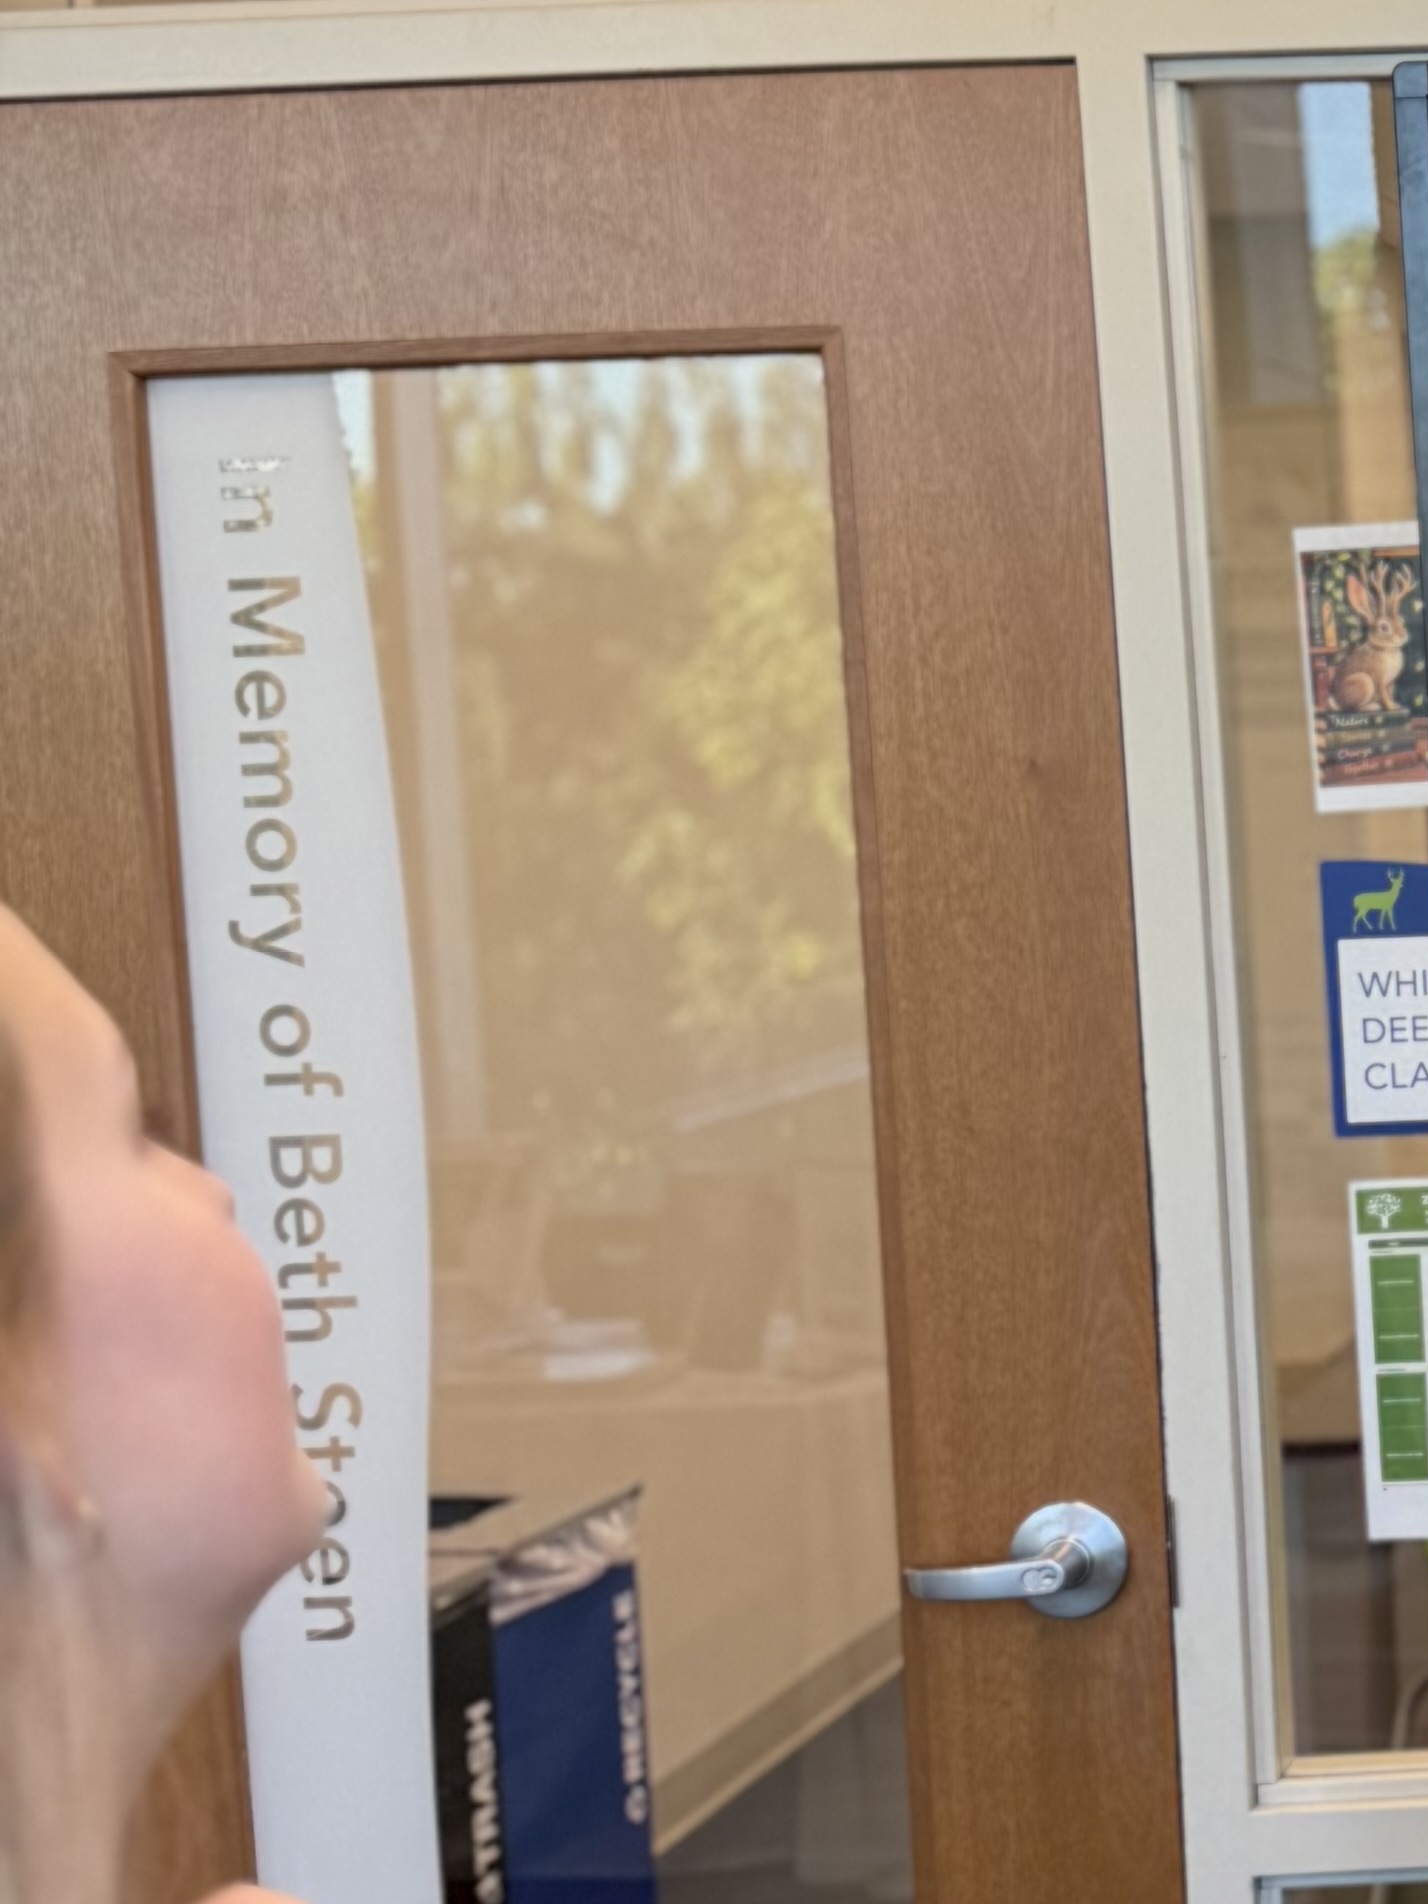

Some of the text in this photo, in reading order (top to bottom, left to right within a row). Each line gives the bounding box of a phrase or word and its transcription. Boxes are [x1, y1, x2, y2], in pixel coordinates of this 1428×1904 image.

[219, 456, 291, 533] In
[226, 575, 305, 968] Memory
[259, 1003, 344, 1099] of
[269, 1133, 358, 1343] Beth
[465, 1699, 501, 1874] TRASH
